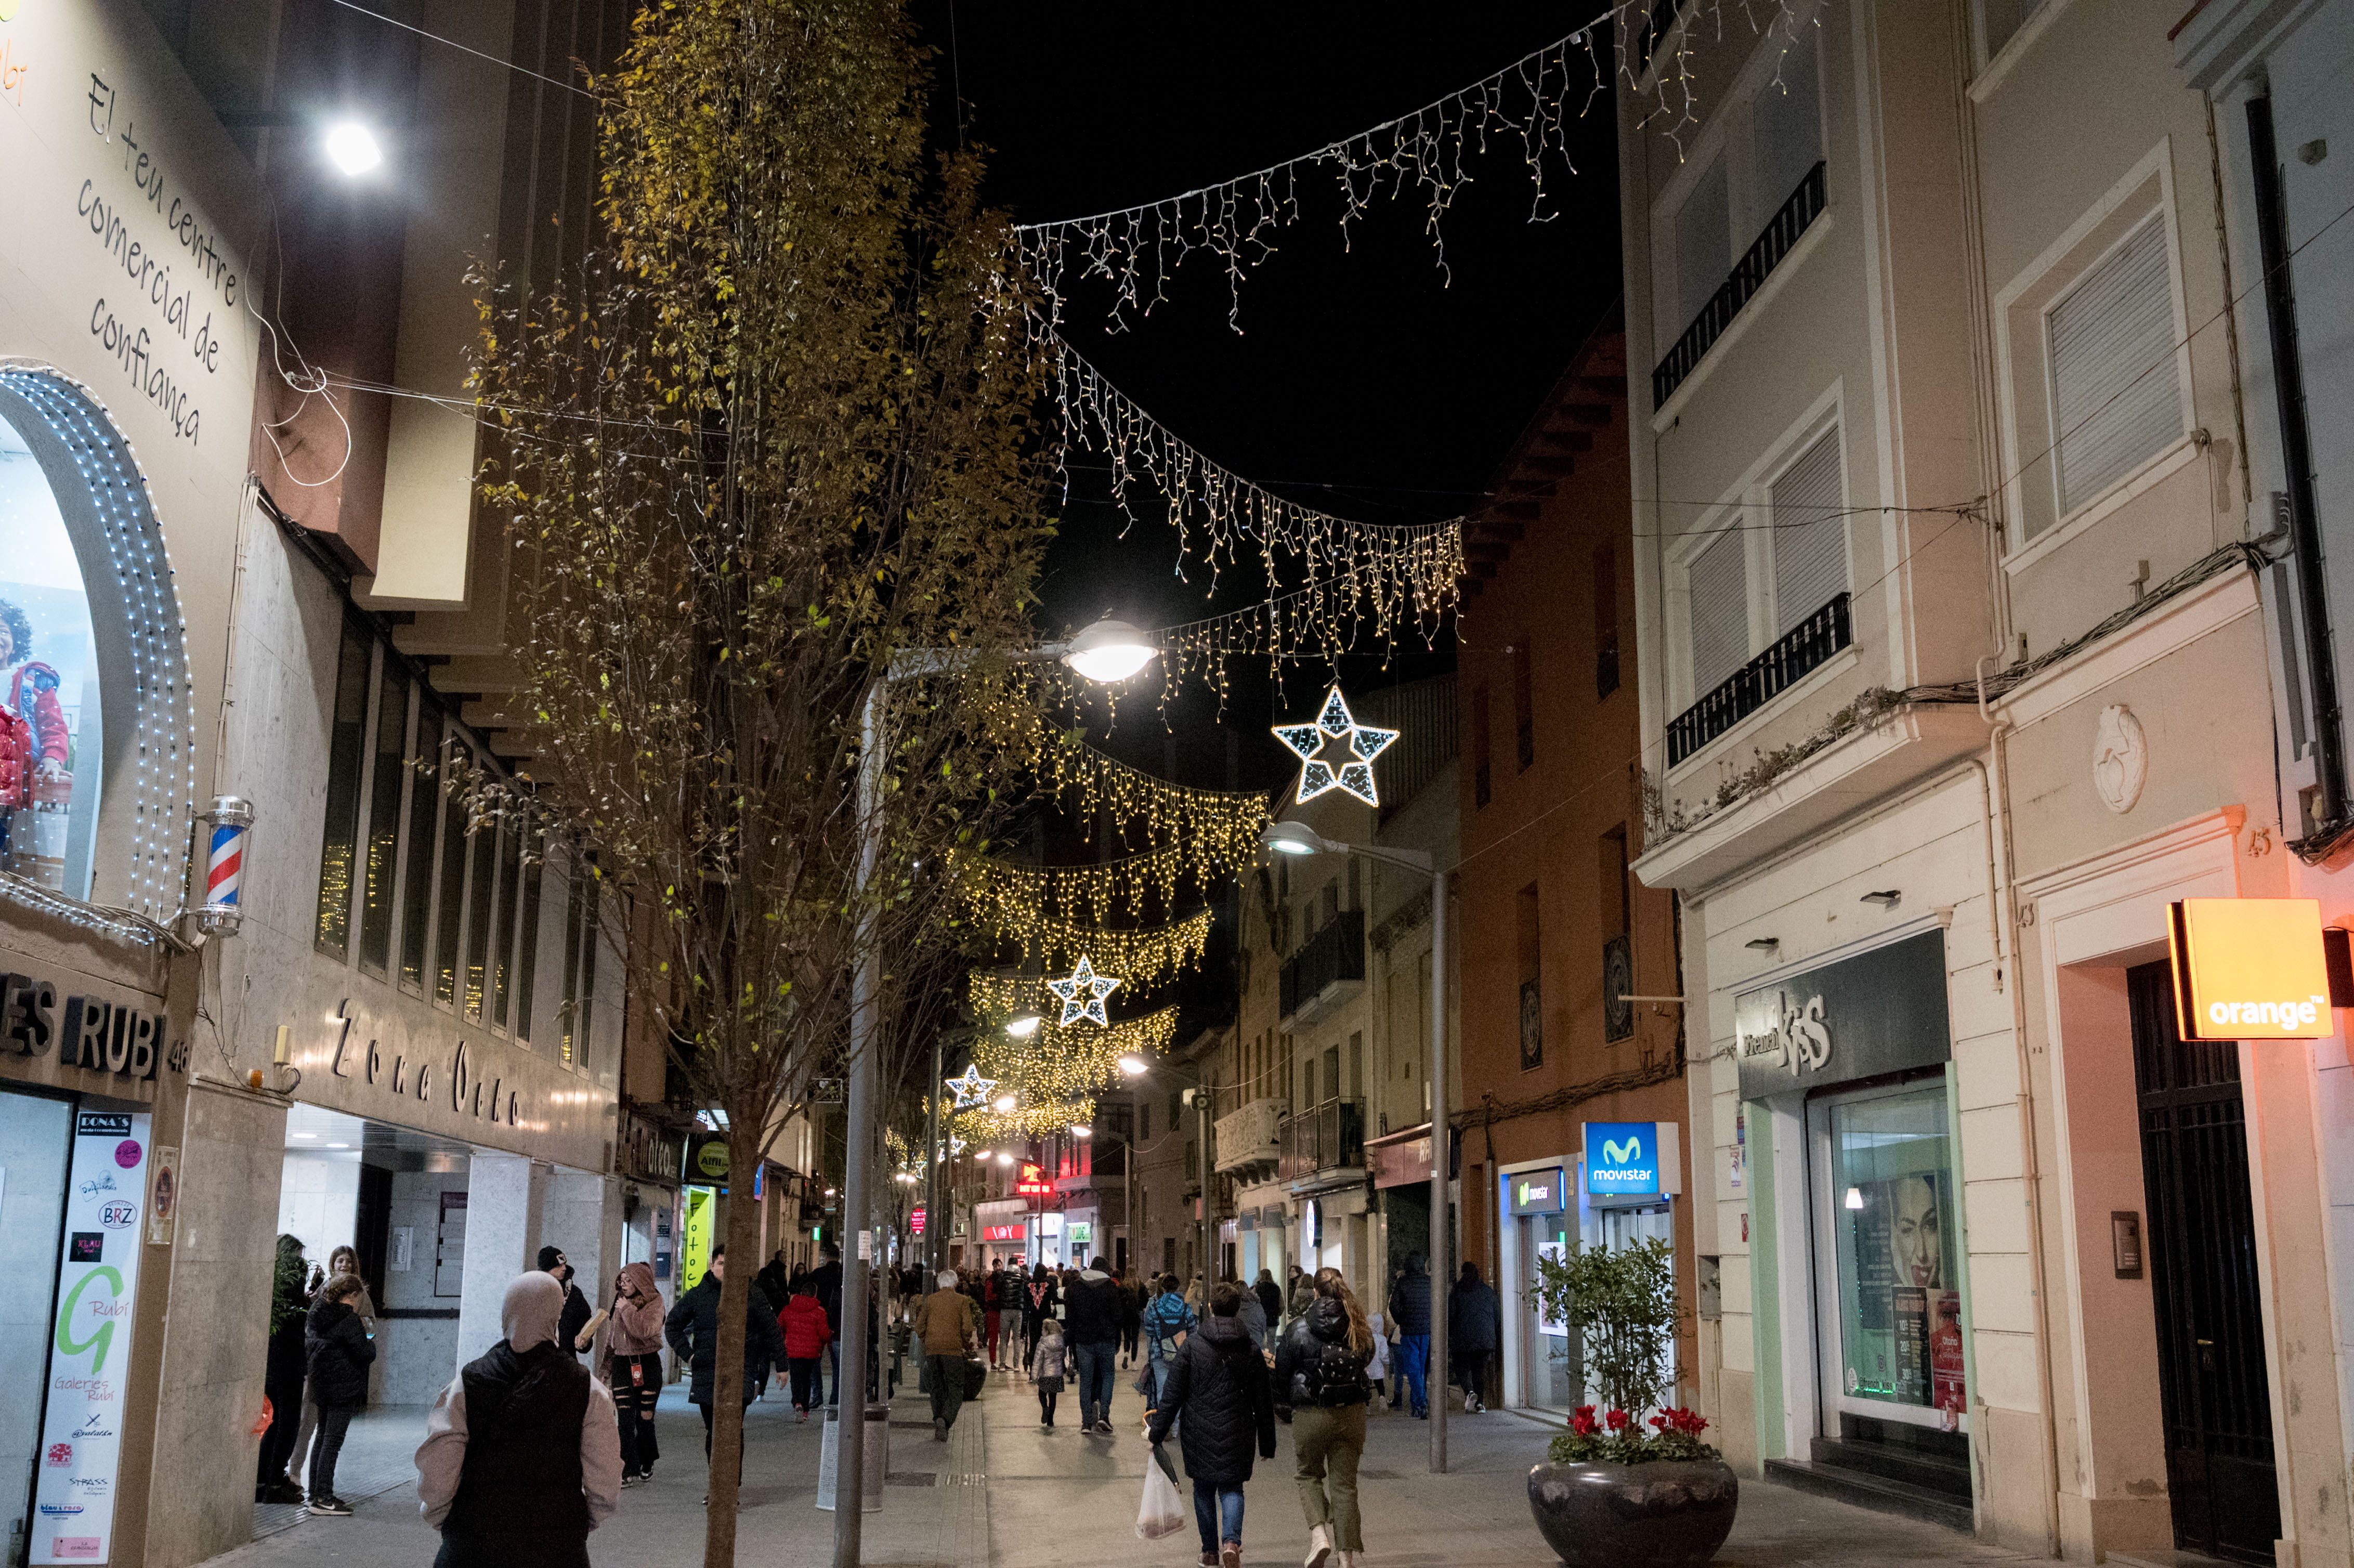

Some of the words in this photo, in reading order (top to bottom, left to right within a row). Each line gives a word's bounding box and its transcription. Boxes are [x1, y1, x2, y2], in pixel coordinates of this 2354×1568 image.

[88, 72, 115, 145] El
[121, 122, 162, 214] teu
[169, 198, 236, 307] centre
[78, 179, 190, 339] comercial
[194, 312, 219, 373] de
[90, 298, 200, 447] confiança
[2209, 1001, 2317, 1030] orange
[331, 998, 432, 1102] Zona
[1743, 1027, 1780, 1057] French
[169, 1039, 190, 1073] 46
[1593, 1169, 1652, 1181] movistar
[1529, 1185, 1548, 1200] movistar
[104, 1208, 133, 1224] BRZ
[88, 1301, 129, 1316] Rubí
[55, 1377, 108, 1390] Galeries
[85, 1389, 114, 1402] Rubí
[70, 1478, 108, 1486] STRASS
